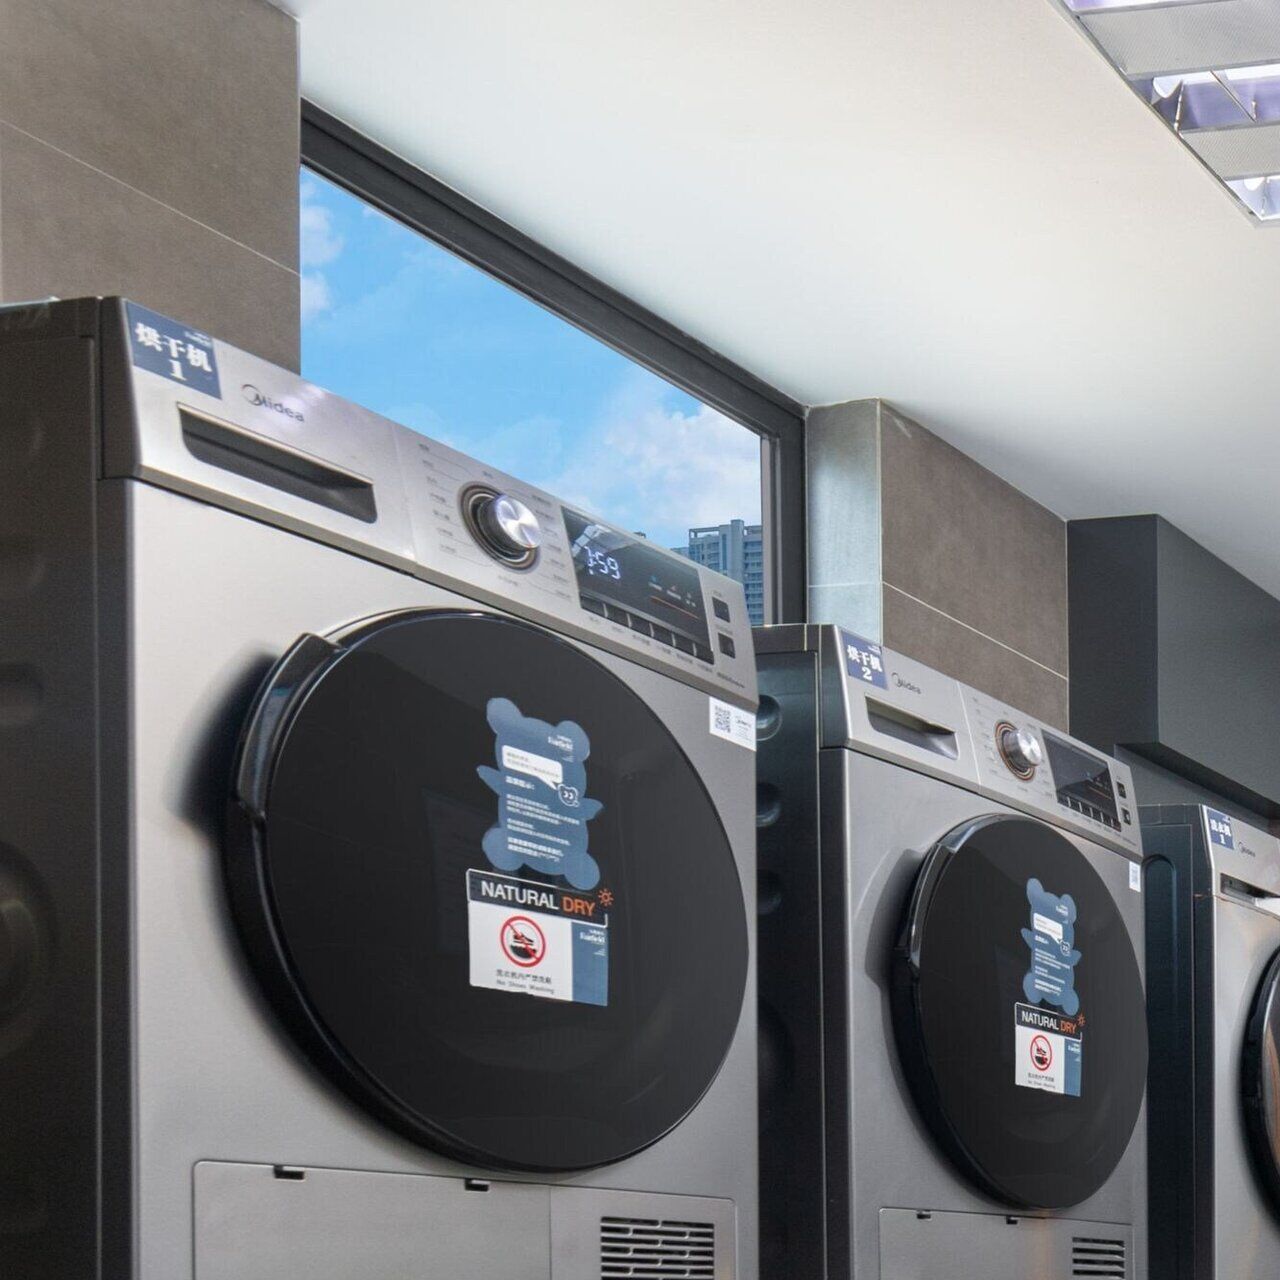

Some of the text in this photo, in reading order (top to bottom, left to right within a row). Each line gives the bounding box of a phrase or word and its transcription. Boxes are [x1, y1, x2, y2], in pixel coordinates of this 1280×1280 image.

[135, 322, 213, 373] 烘干机
[169, 359, 187, 381] 1
[241, 383, 305, 423] Midea
[861, 666, 873, 681] 2
[480, 880, 597, 917] NATURAL DRY
[1020, 1009, 1078, 1035] NATURAL DRY
